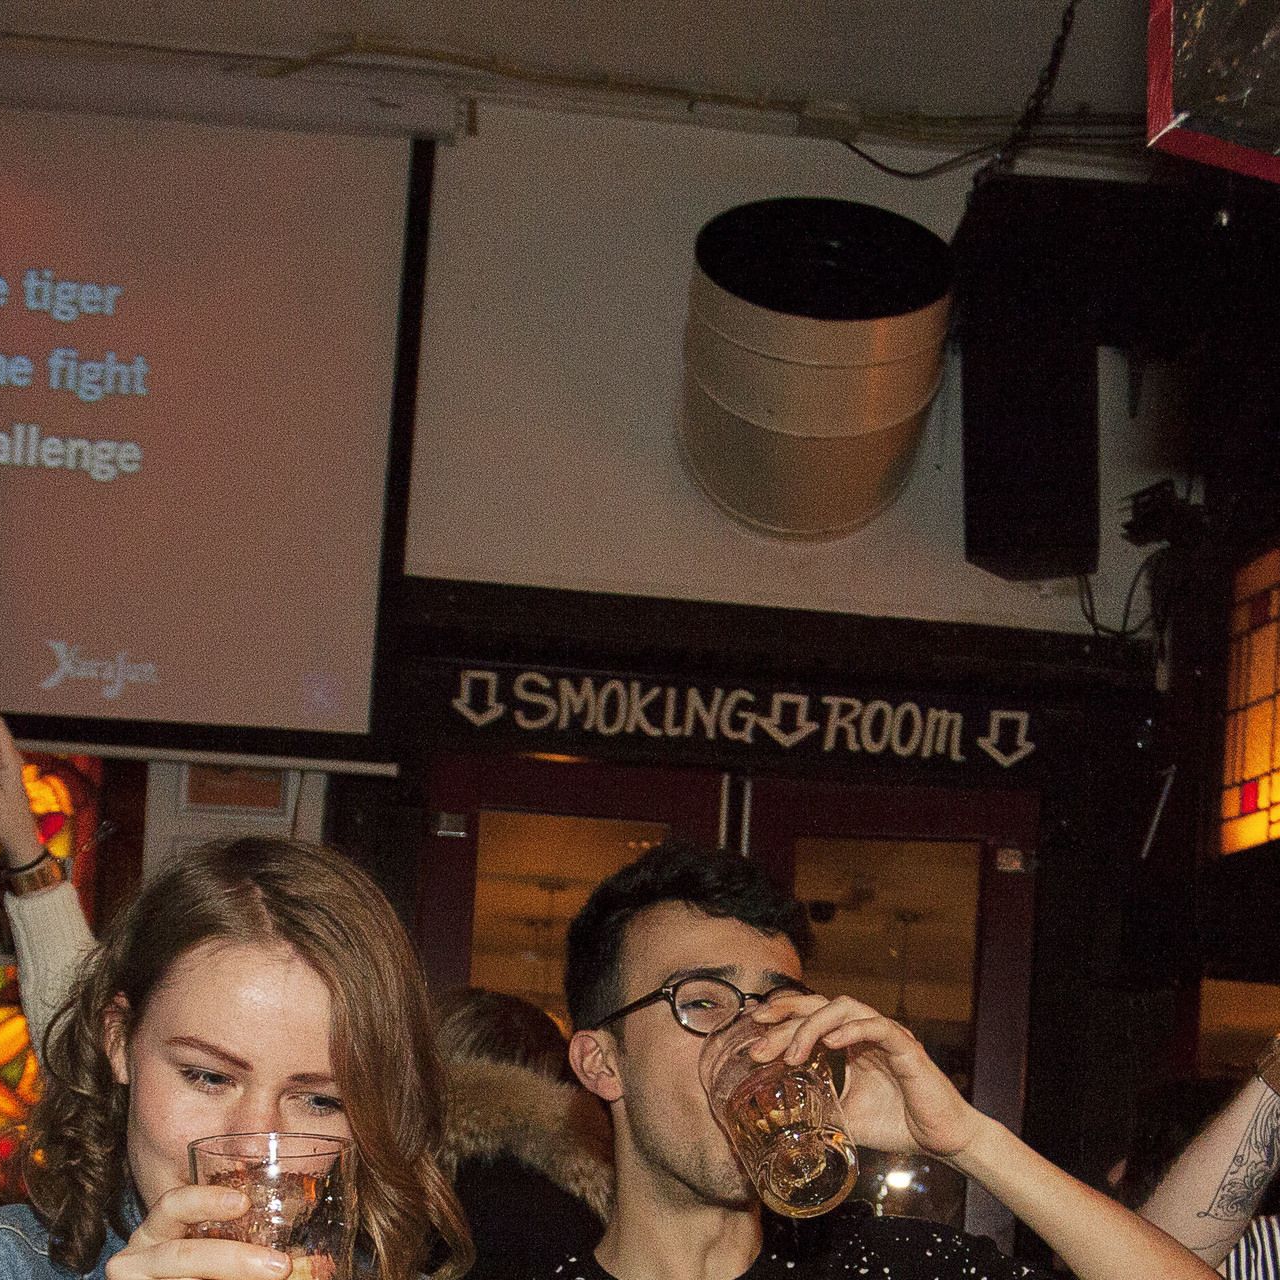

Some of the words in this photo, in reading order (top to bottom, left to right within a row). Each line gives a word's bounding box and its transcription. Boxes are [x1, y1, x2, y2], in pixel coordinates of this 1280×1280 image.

[24, 269, 121, 322] tiger
[48, 348, 149, 402] fight
[514, 671, 758, 743] SMOKING
[822, 695, 966, 763] ROOM
